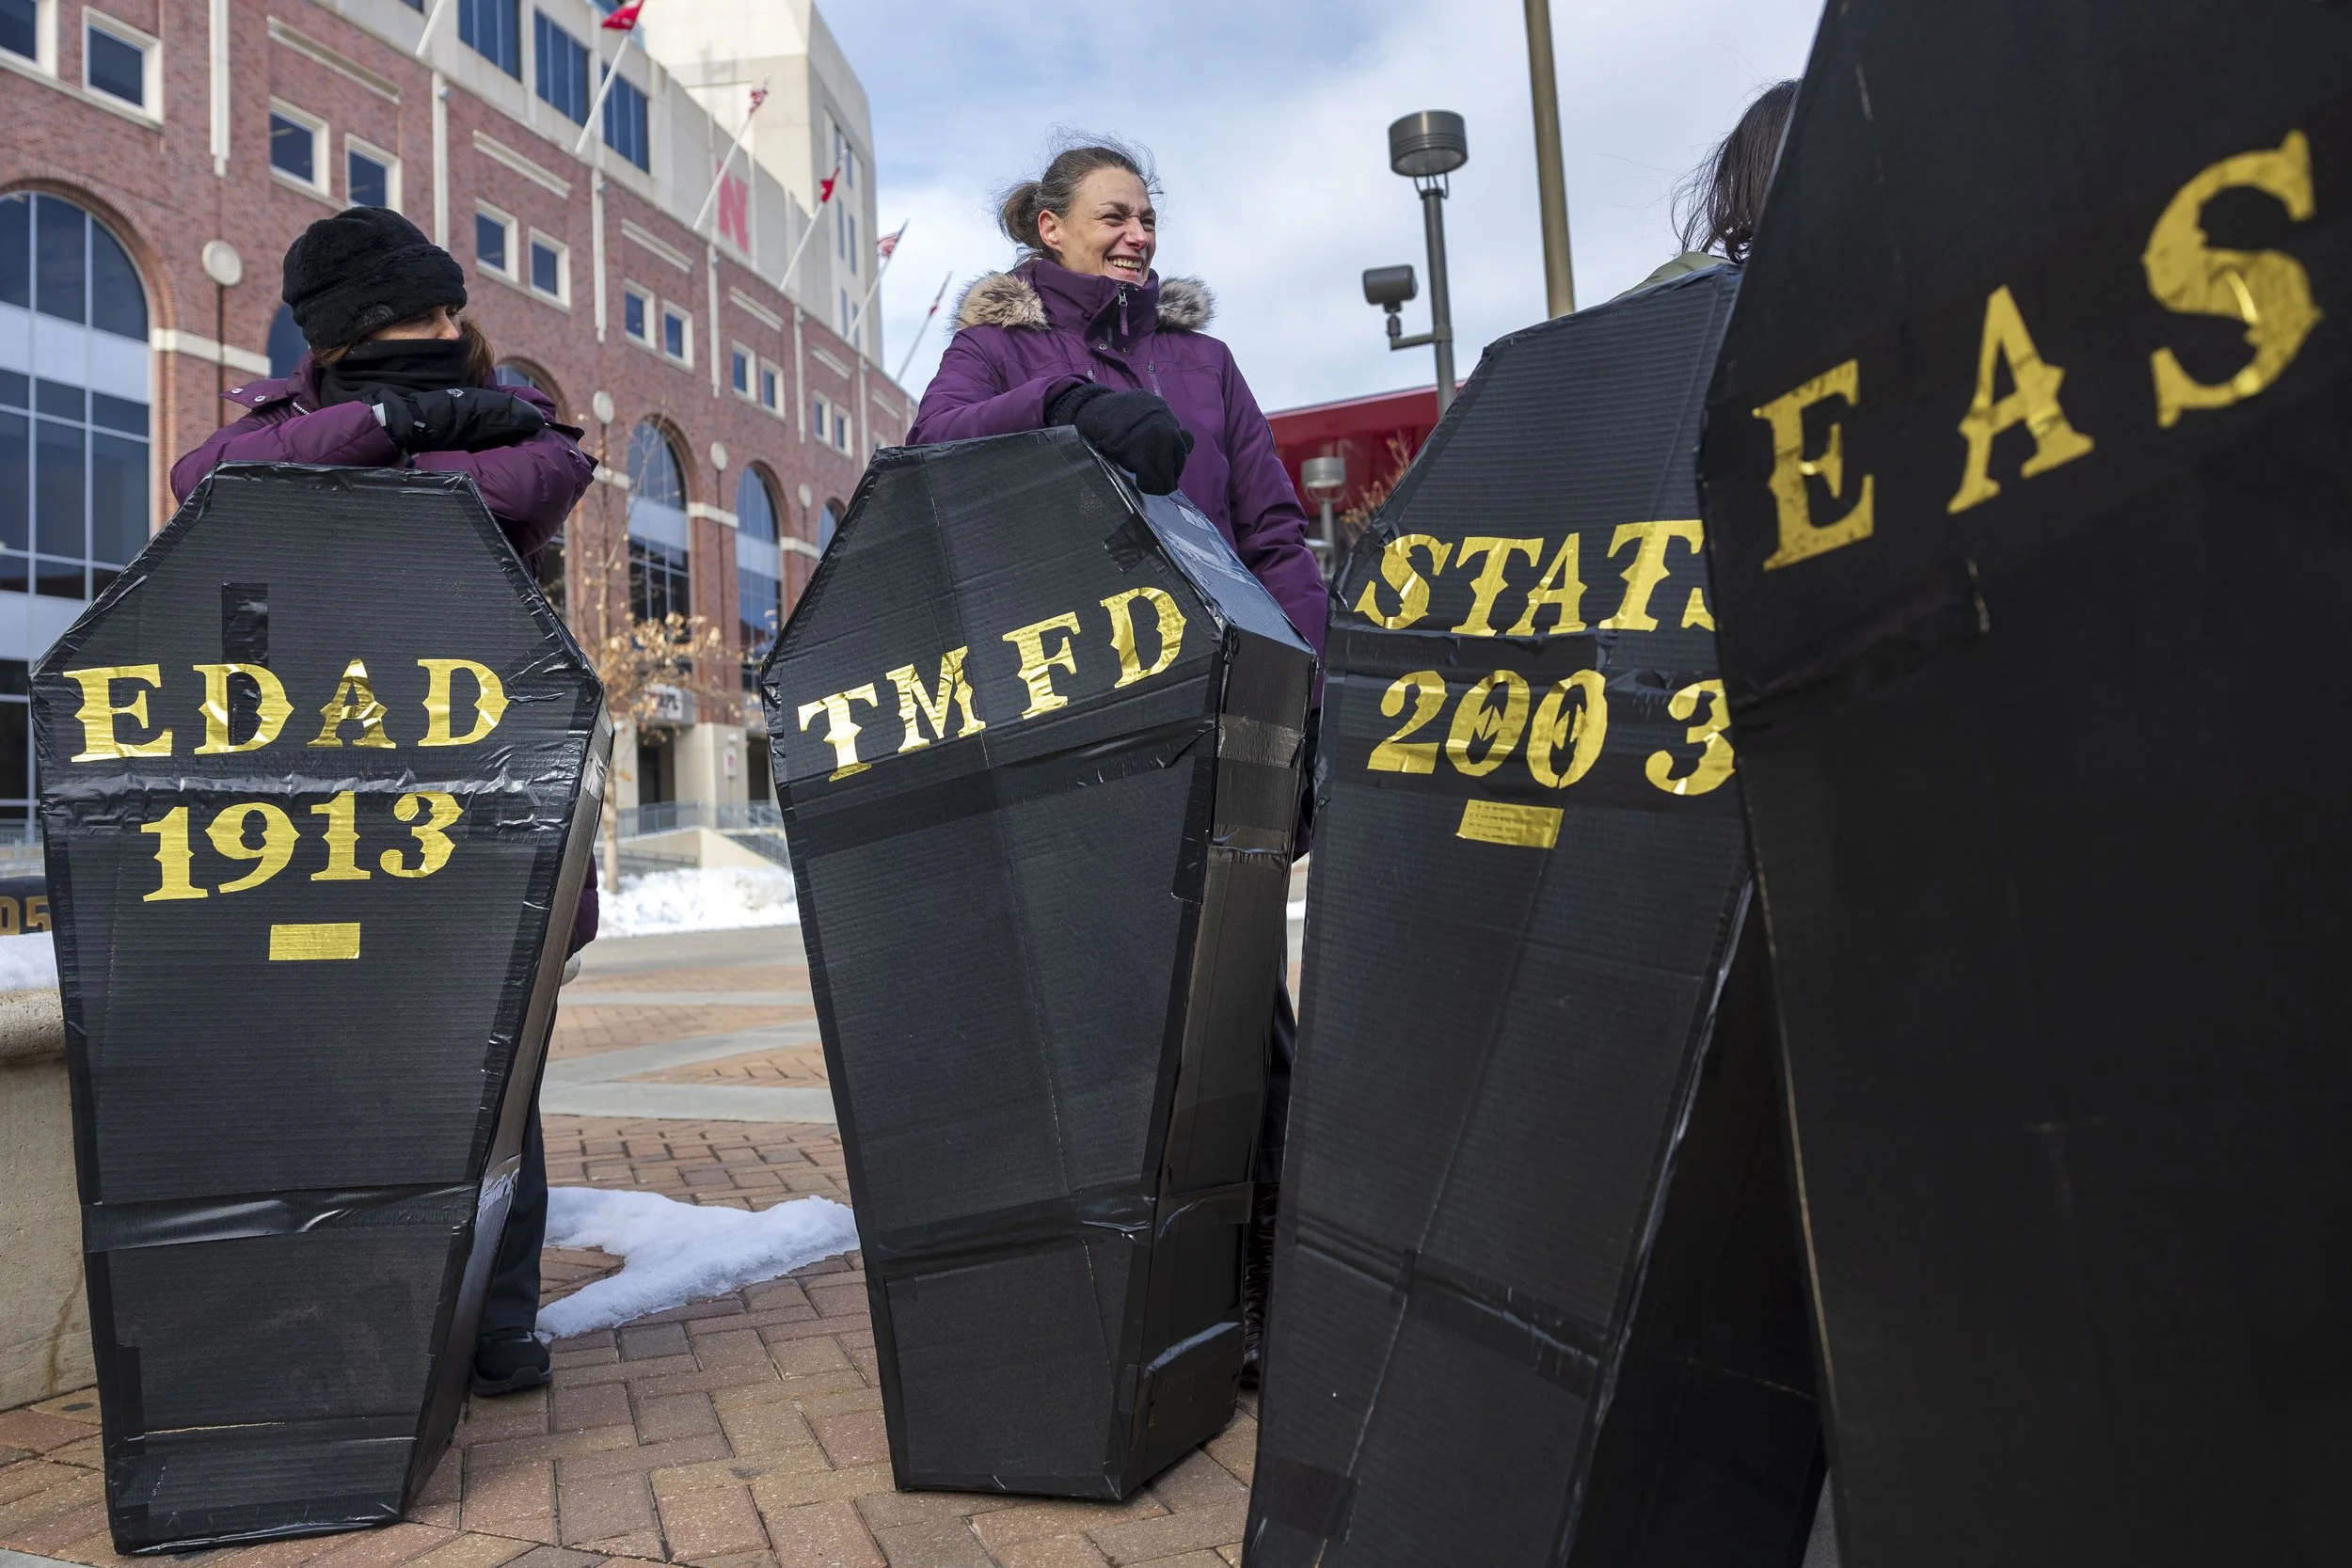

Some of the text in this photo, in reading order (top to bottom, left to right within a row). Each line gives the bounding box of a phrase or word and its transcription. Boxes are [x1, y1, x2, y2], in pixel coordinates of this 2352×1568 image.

[1753, 129, 2324, 571] EAS
[63, 658, 510, 763] EDAD
[798, 587, 1187, 782] TMFD
[1366, 669, 1736, 796] 2003
[140, 790, 464, 902] 1913
